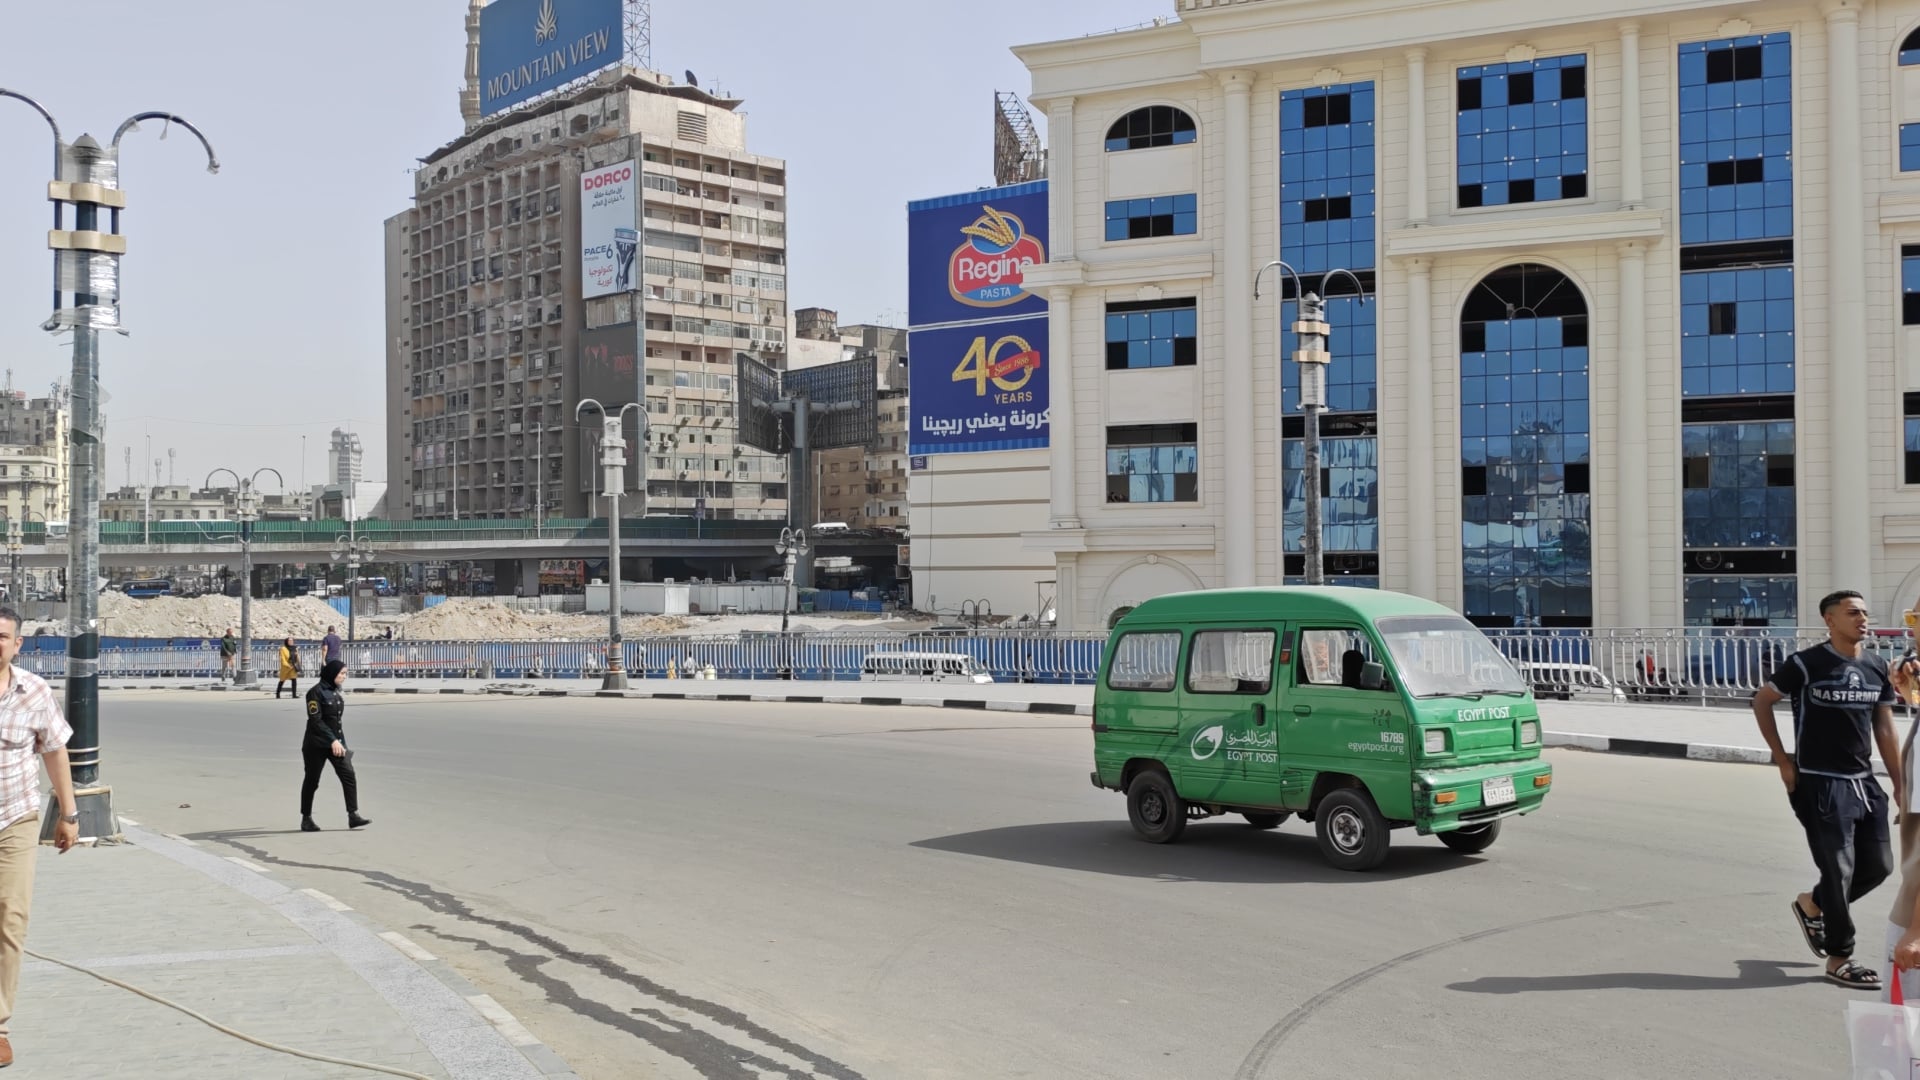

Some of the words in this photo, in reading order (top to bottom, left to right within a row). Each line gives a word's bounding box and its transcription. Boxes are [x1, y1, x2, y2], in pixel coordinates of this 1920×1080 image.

[487, 46, 566, 102] MOUNTAIN
[569, 26, 610, 66] VIEW
[584, 167, 631, 191] DORCO
[980, 286, 1011, 299] PASTA
[952, 334, 1034, 397] 40
[994, 391, 1033, 405] YEARS
[966, 412, 1006, 434] يعني
[1458, 708, 1486, 721] EGYPT
[1489, 706, 1511, 719] POST
[1380, 732, 1404, 744] 16789
[1347, 741, 1405, 755] egyptpost.org
[1227, 751, 1253, 762] EGYPT
[1256, 752, 1277, 763] POST
